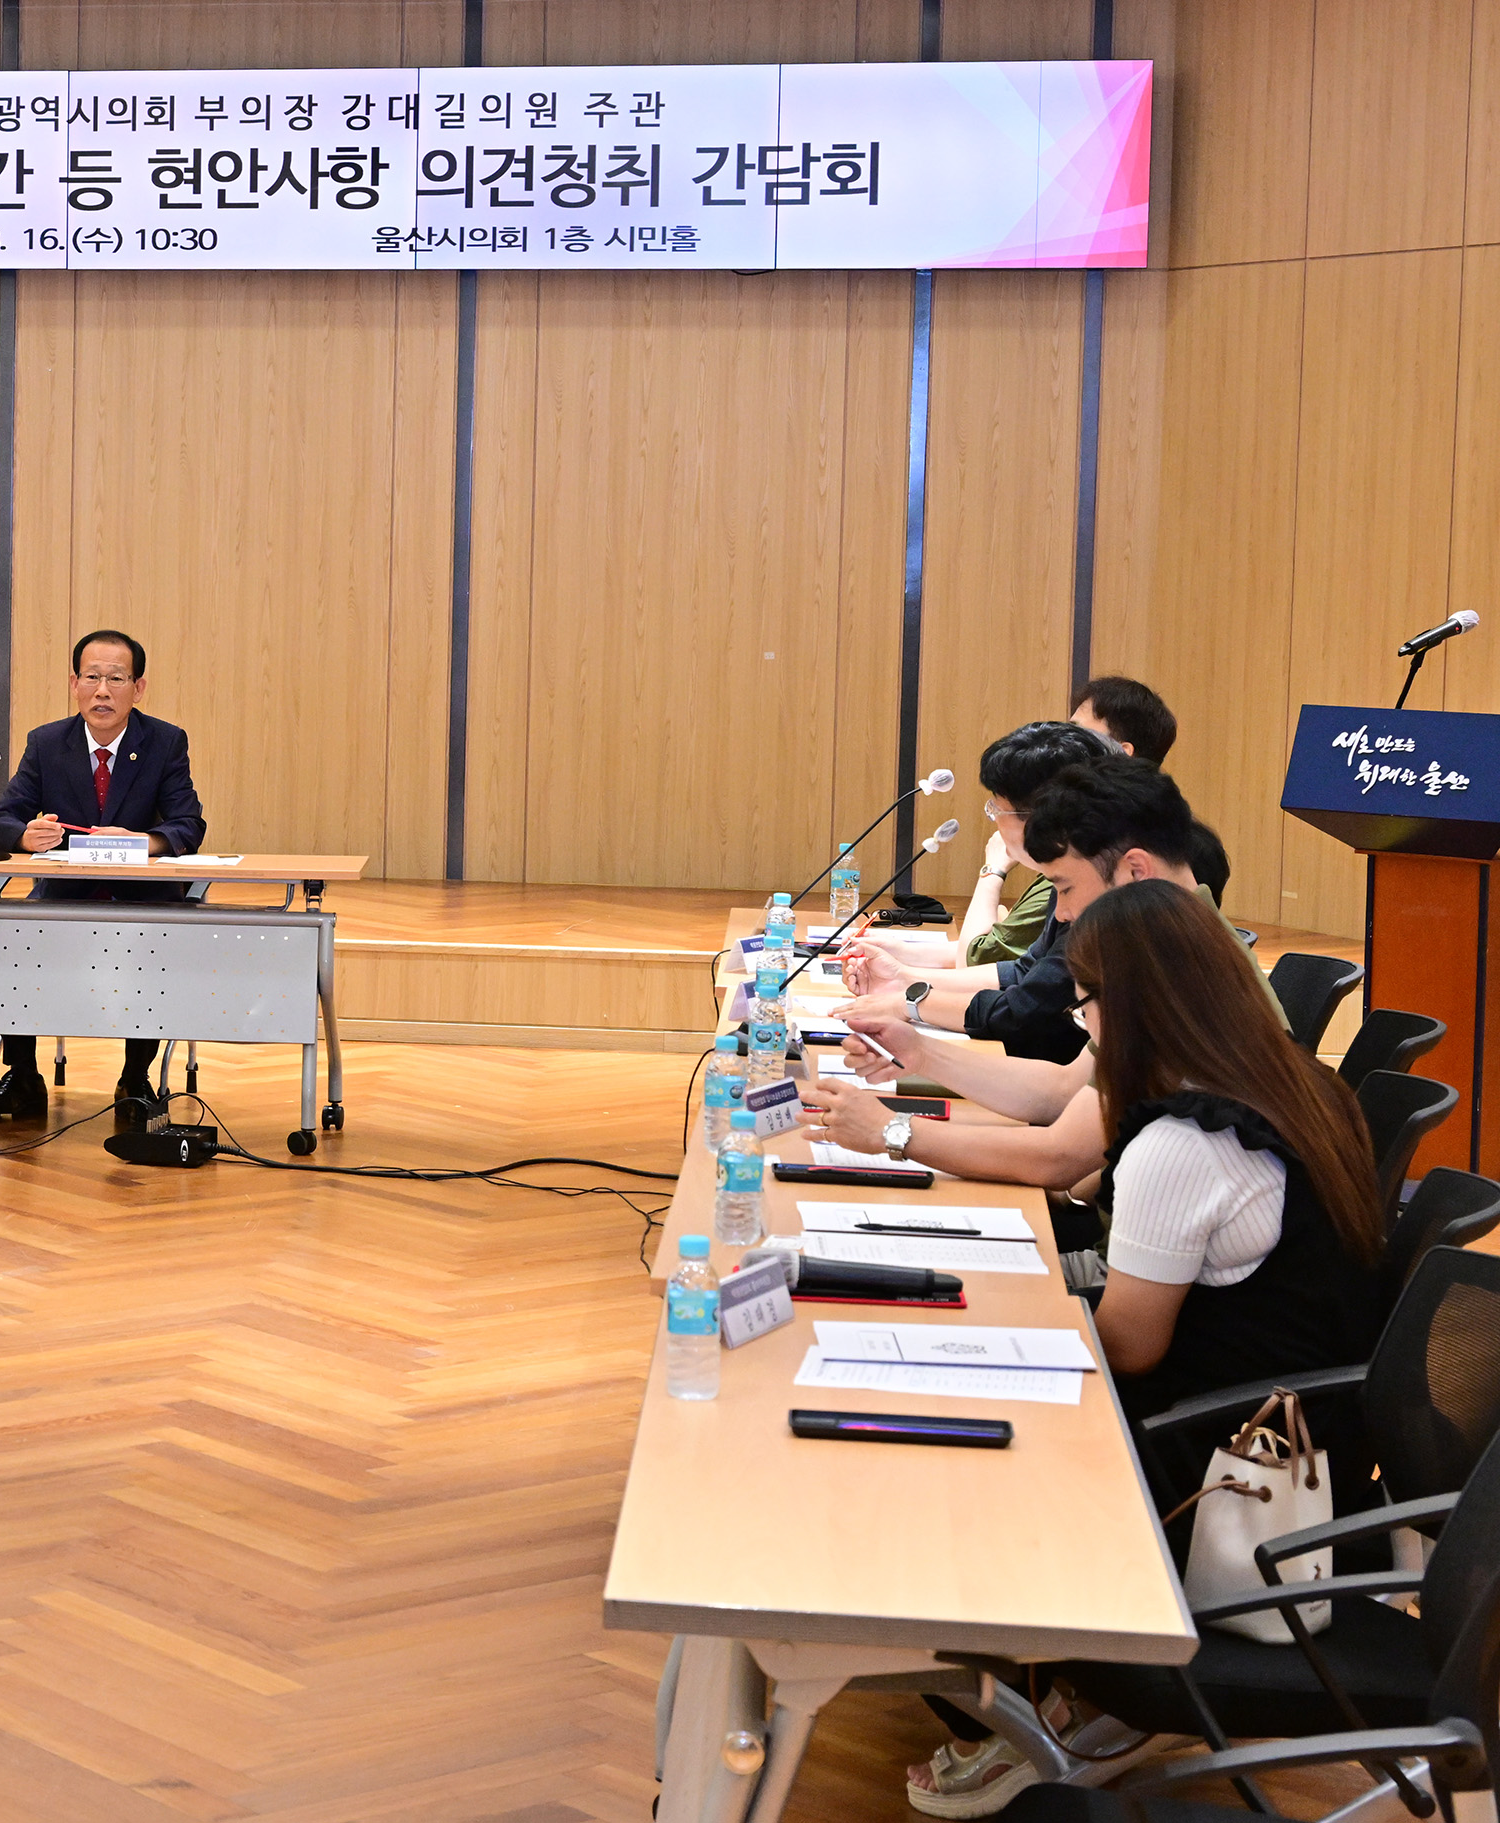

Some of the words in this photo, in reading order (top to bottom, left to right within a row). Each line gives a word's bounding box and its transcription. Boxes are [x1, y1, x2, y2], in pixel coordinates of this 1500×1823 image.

[194, 94, 319, 131] 부의장
[341, 92, 558, 130] 강대길의원
[583, 91, 666, 128] 주관
[59, 150, 122, 211] 등
[148, 146, 390, 210] 현안사항
[416, 143, 661, 208] 의견청취
[691, 141, 880, 207] 간담회
[23, 227, 123, 253] 16.(수)
[135, 228, 218, 251] 10:30
[371, 226, 528, 252] 울산시의회
[544, 226, 595, 253] 1층
[604, 225, 701, 252] 시민홀
[1332, 725, 1374, 767] 새로
[1375, 734, 1416, 754] 만드는
[1354, 759, 1418, 795] 위대한
[1420, 761, 1470, 796] 울산
